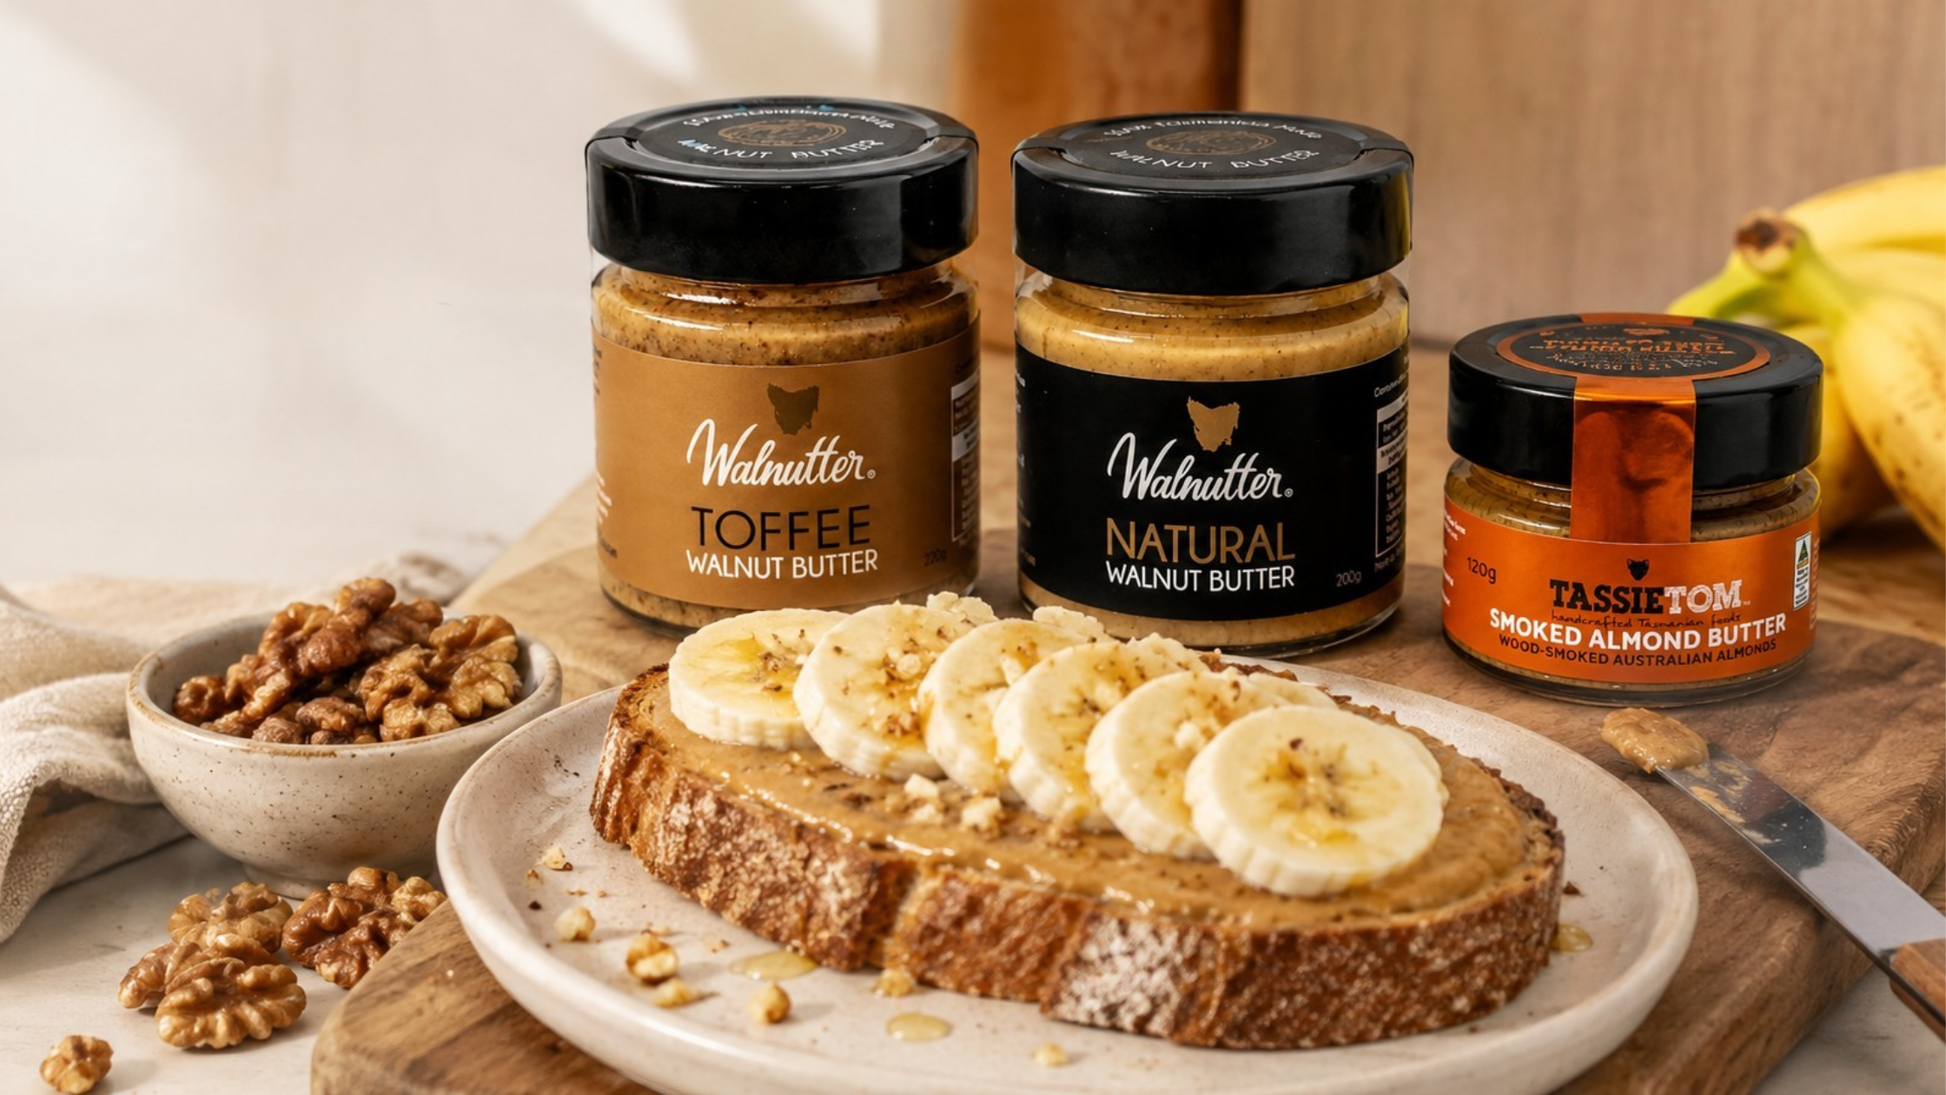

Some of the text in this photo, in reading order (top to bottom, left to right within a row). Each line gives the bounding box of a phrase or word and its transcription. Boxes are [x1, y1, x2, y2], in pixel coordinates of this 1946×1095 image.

[690, 504, 871, 552] TOFFEE
[1106, 517, 1296, 564] NATURAL
[686, 549, 879, 580] WALNUT BUTTER
[1105, 560, 1296, 593] WALNUT BUTTER
[1335, 570, 1363, 588] 200g
[1466, 556, 1498, 585] 120g
[1489, 607, 1787, 652] SMOKED ALMOND BUTTER
[1498, 632, 1777, 667] WOOD-SMOKED AUSTRALIAN ALMONDS
